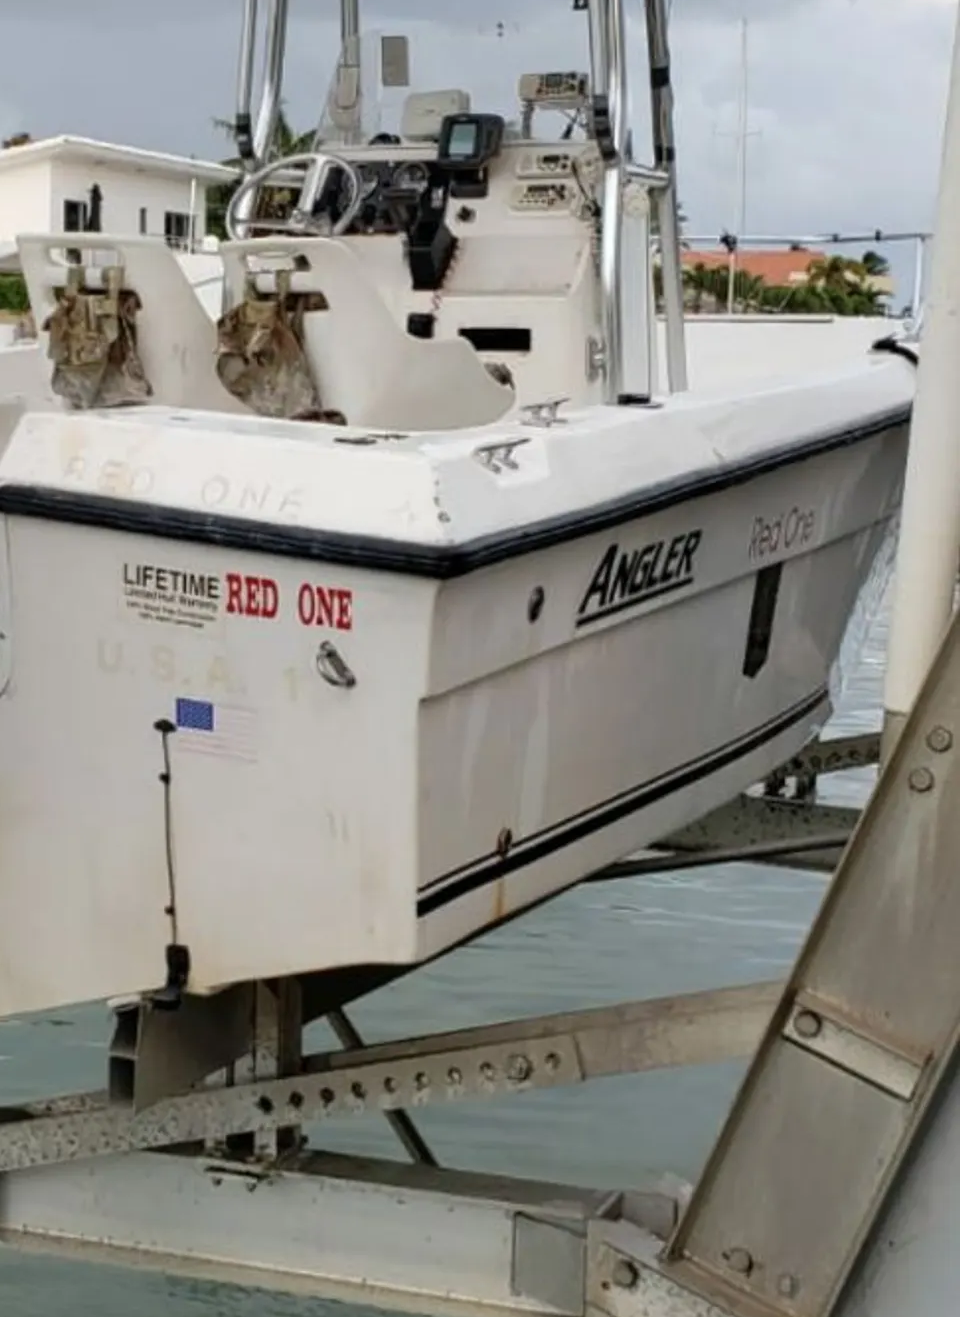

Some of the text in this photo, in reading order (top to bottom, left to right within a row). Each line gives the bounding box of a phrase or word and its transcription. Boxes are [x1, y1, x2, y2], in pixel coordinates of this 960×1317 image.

[123, 562, 220, 599] LIFETIME
[225, 572, 280, 619] RED
[297, 582, 353, 631] ONE
[578, 529, 703, 615] ANGLER
